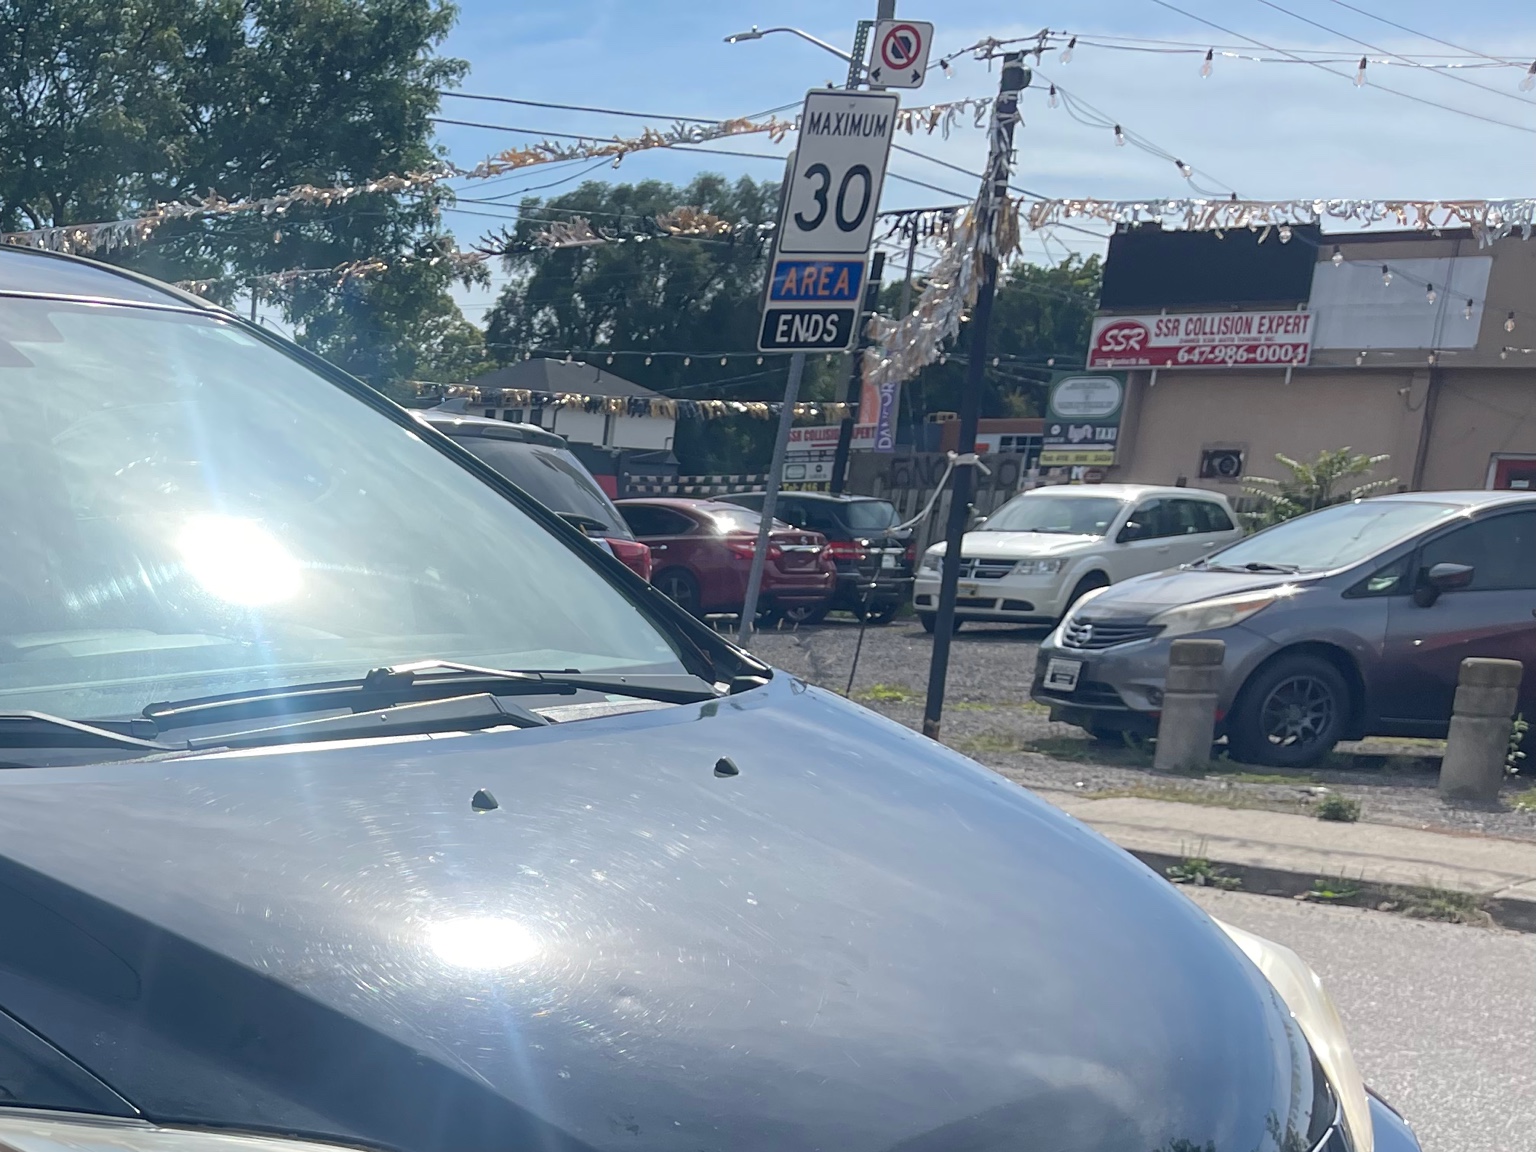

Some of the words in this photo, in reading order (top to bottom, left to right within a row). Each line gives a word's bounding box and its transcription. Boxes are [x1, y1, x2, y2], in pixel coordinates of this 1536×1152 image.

[807, 111, 888, 138] MAXIMUM
[794, 162, 872, 233] 30
[781, 266, 850, 297] AREA
[775, 313, 839, 343] ENDS
[1101, 327, 1145, 352] SSR
[1154, 318, 1181, 338] SSR
[1184, 316, 1252, 337] COLLISION
[1257, 314, 1310, 335] EXPERT
[1177, 344, 1306, 364] 647-986-0004
